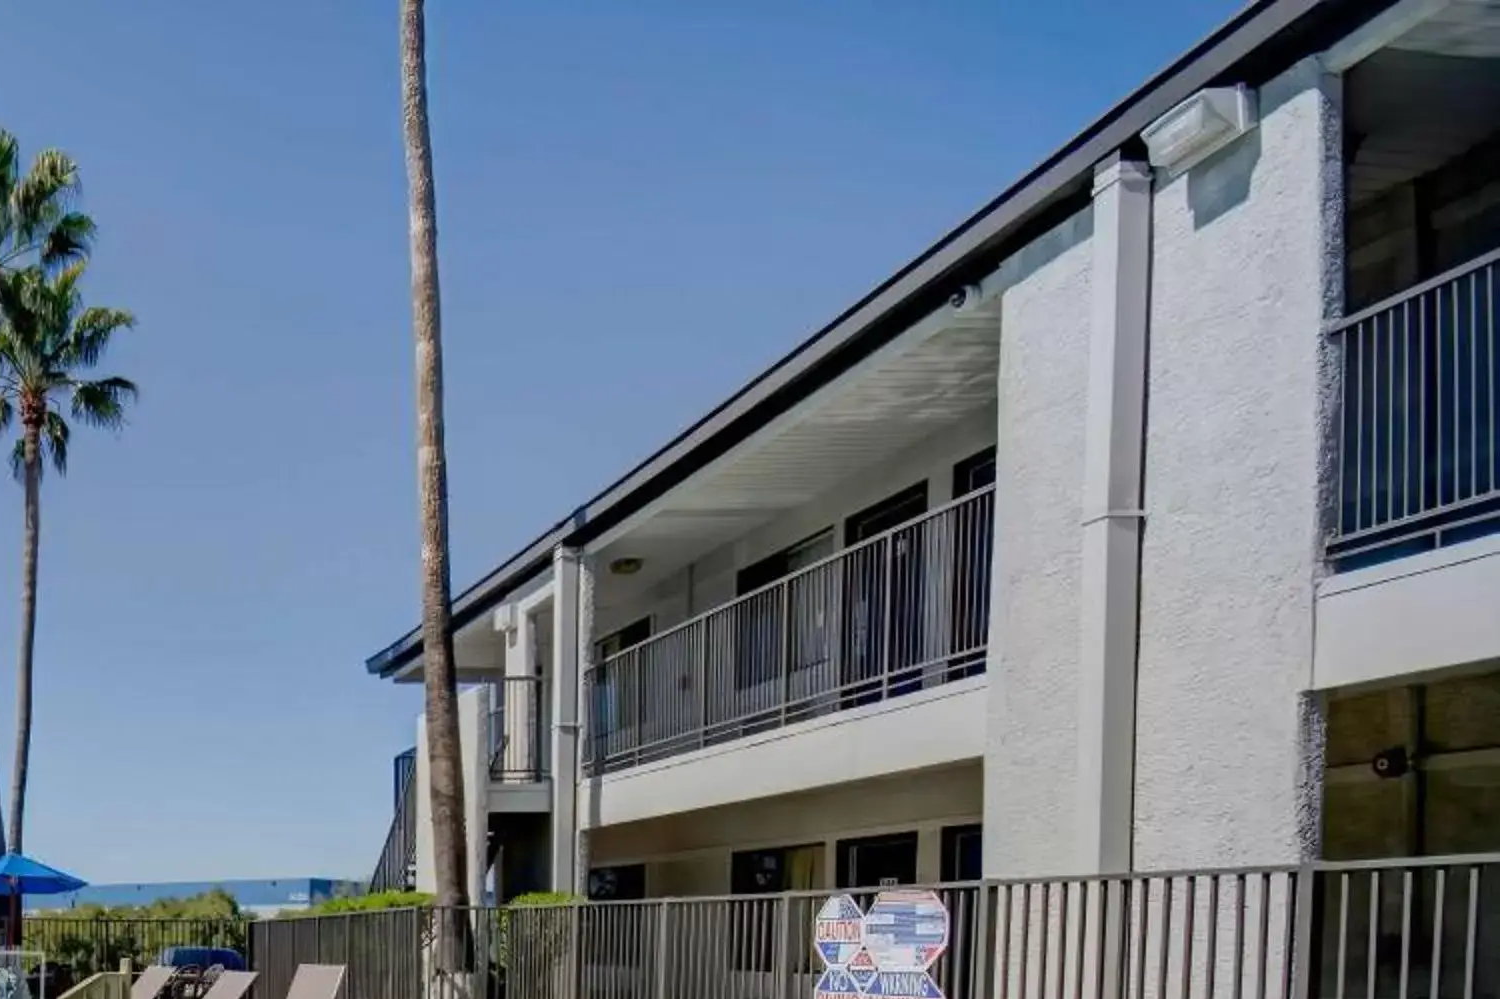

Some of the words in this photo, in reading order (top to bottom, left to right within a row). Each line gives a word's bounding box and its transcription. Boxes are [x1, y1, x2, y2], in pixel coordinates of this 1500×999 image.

[817, 920, 860, 940] CAUTION
[829, 970, 849, 991] NO
[880, 972, 928, 996] WARNING
